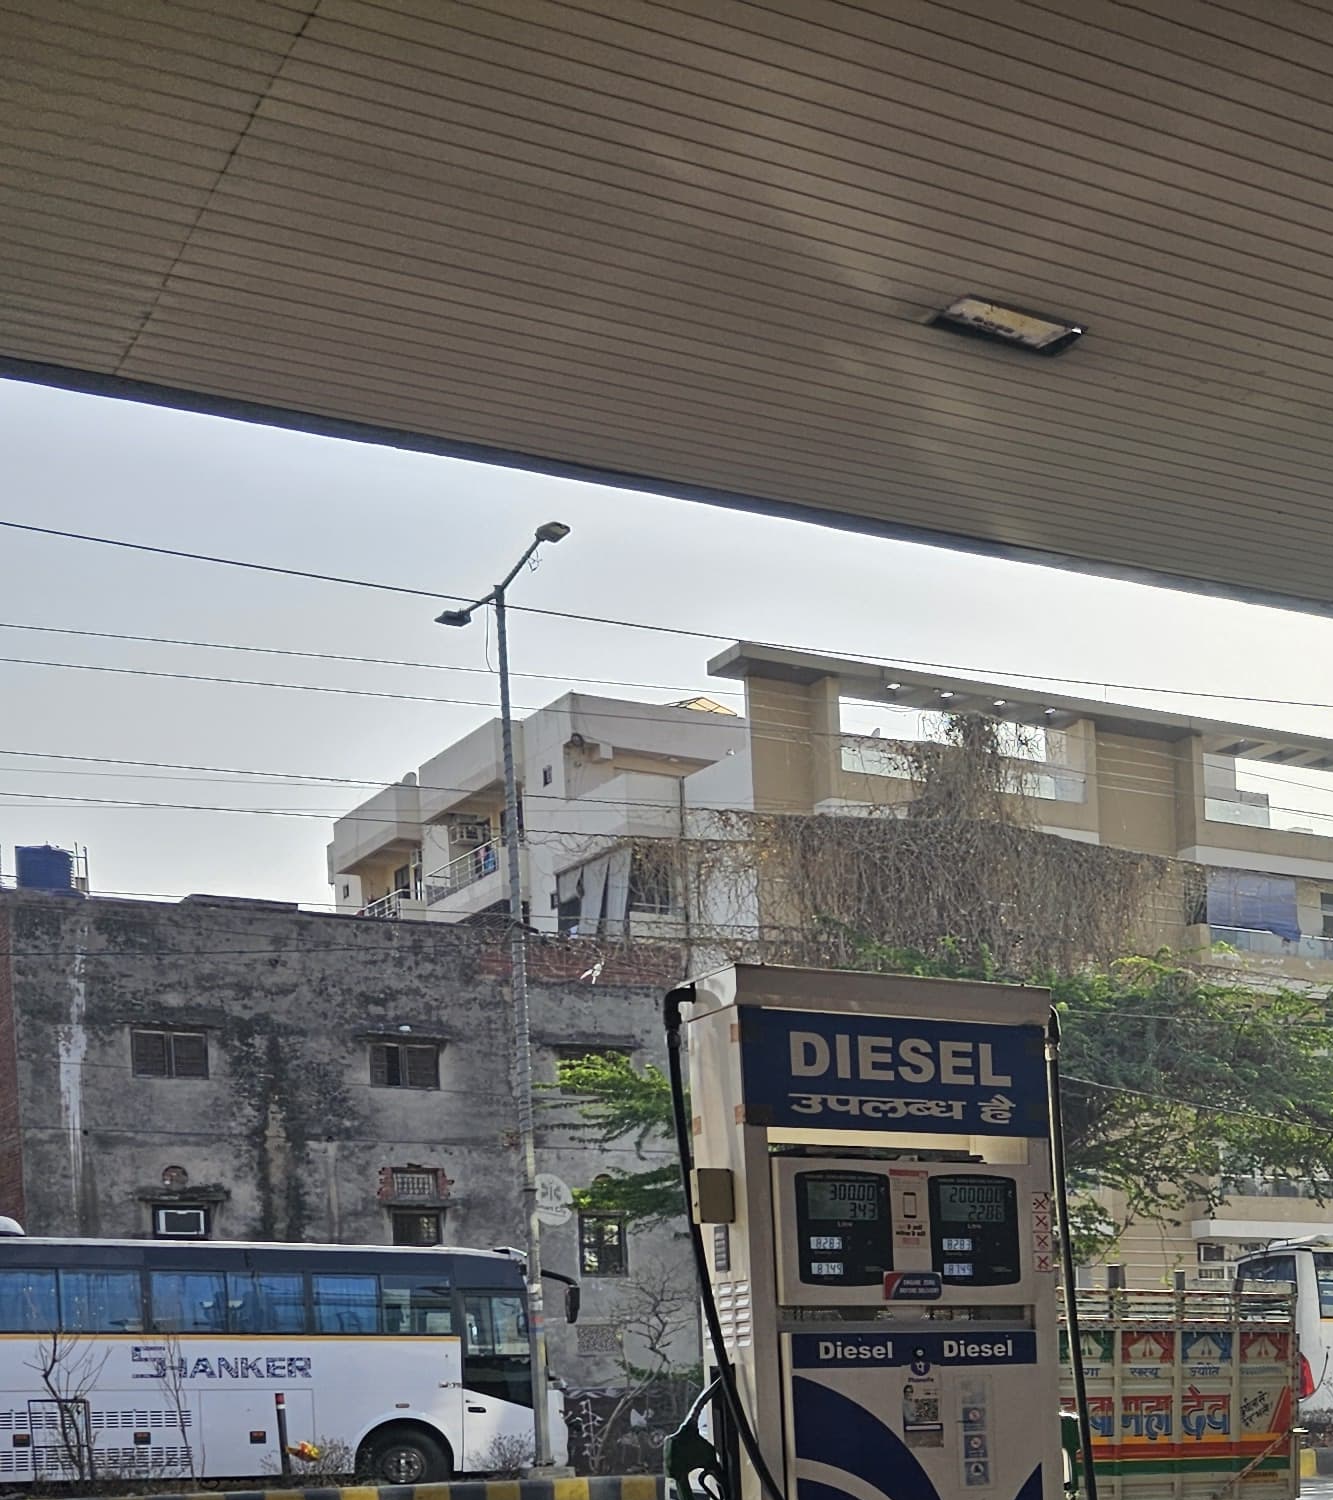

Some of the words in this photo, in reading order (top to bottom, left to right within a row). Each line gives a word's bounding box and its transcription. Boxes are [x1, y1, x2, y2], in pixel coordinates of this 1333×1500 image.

[789, 1031, 1012, 1088] DIESEL
[788, 1093, 966, 1121] उपलब्ध
[978, 1094, 1017, 1125] है
[132, 1346, 312, 1378] SHANKER
[819, 1341, 893, 1360] Diesel
[943, 1339, 1013, 1358] Diesel
